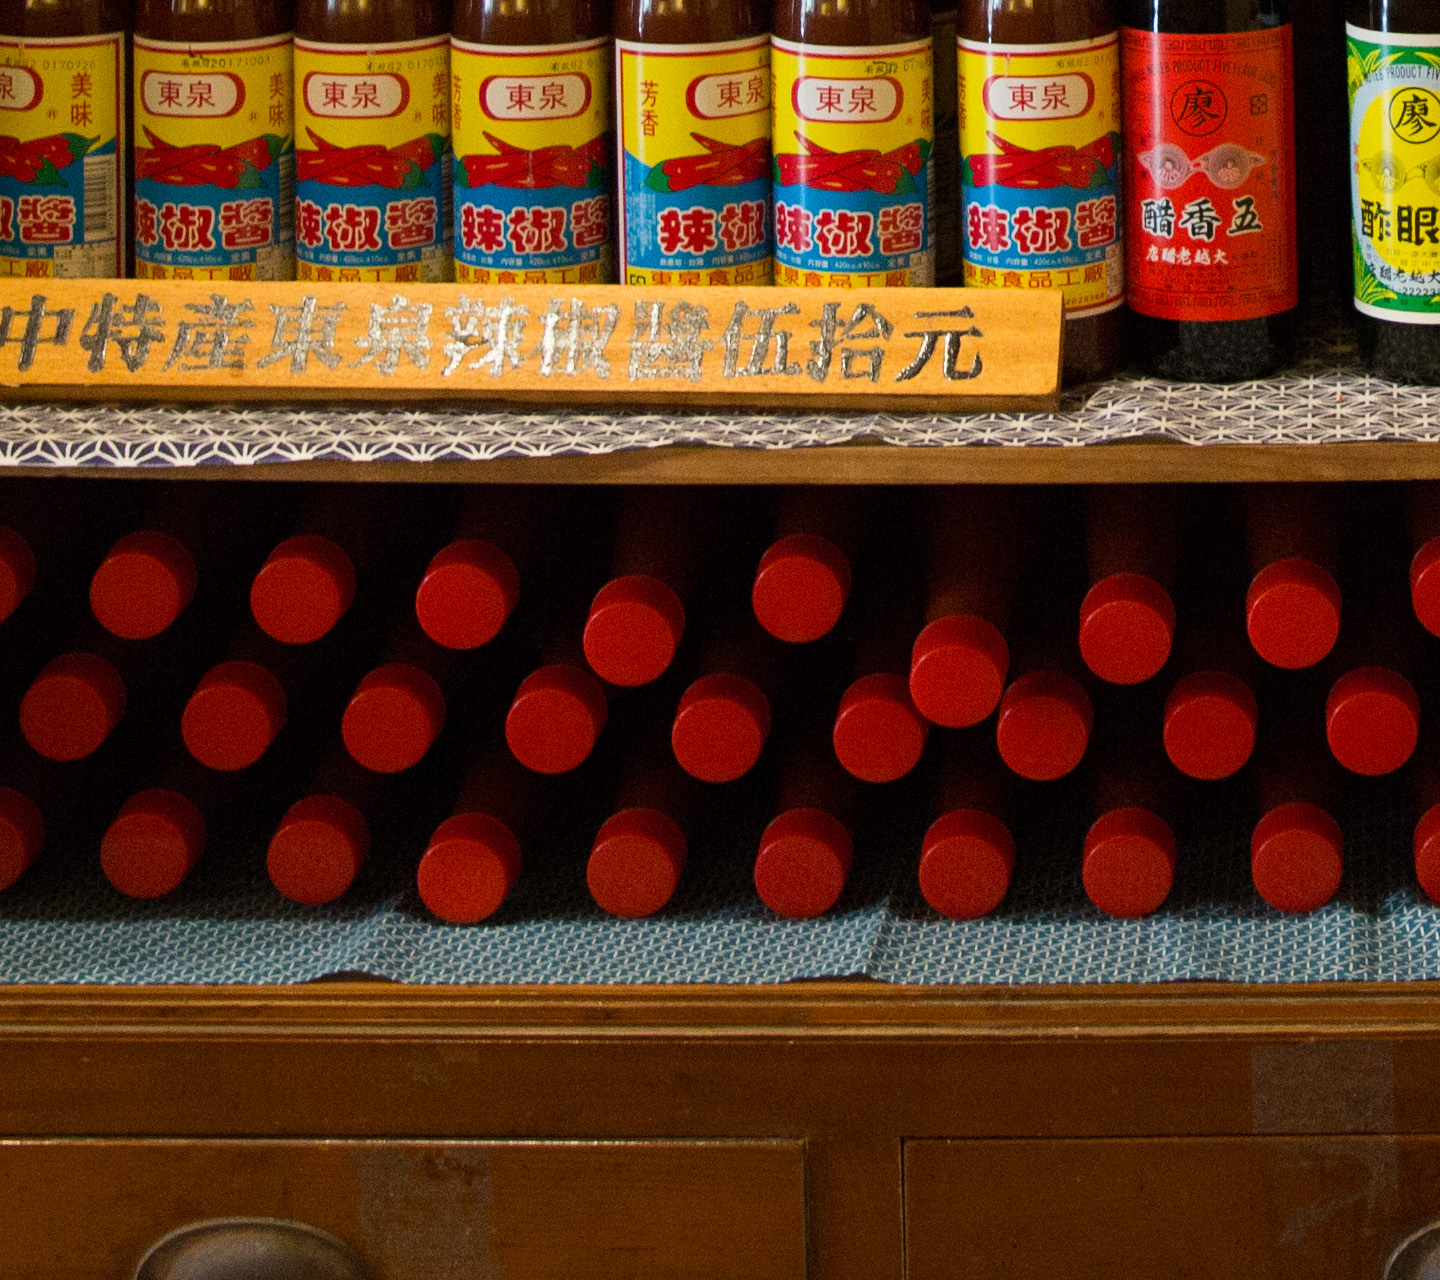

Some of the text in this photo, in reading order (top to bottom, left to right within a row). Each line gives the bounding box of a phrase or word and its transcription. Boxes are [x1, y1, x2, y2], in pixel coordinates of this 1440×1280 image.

[158, 80, 216, 108] 東泉
[717, 75, 764, 109] 東泉
[1387, 65, 1422, 80] PRODUCT
[71, 71, 93, 128] 美味
[268, 71, 285, 128] 美味
[322, 81, 382, 109] 東泉
[506, 82, 568, 111] 東泉
[640, 80, 659, 137] 芳香
[816, 85, 877, 113] 東泉
[1008, 83, 1070, 111] 東泉
[1177, 86, 1220, 130] 廖
[1395, 94, 1437, 137] 廖
[461, 195, 608, 254] 辣椒醬
[775, 201, 924, 257] 辣椒醬
[967, 196, 1117, 255] 辣椒醬
